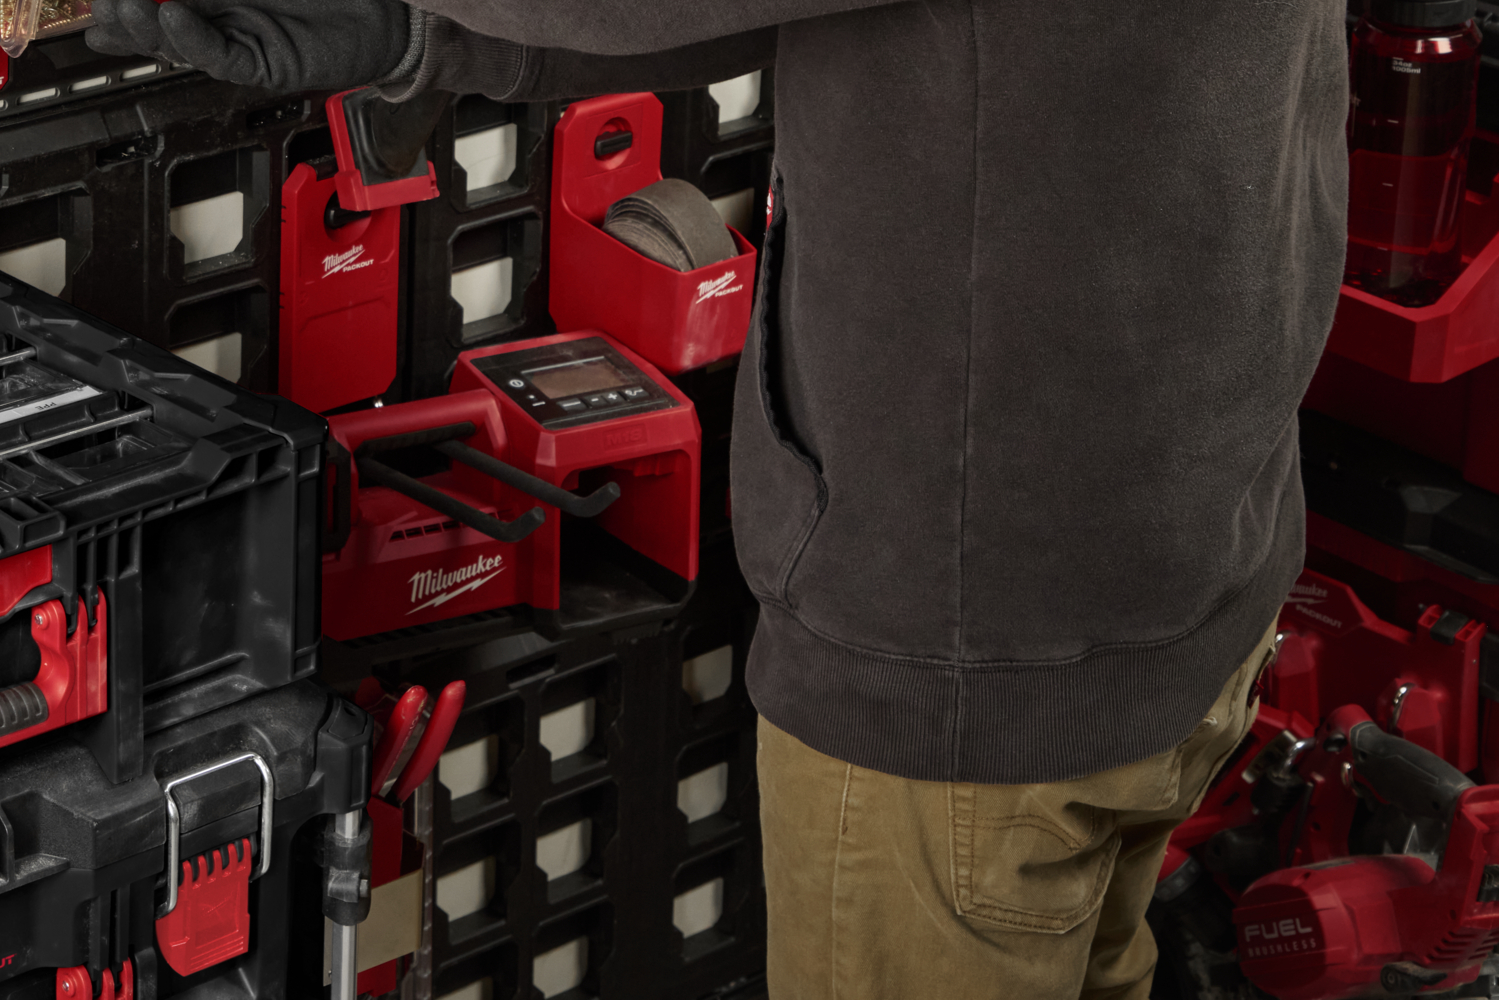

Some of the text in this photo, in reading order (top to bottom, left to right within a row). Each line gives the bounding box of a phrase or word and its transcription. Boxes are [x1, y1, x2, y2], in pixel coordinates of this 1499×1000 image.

[322, 243, 365, 273] Milwaukee
[342, 258, 374, 273] PACKOUT
[697, 270, 736, 297] Milwaukee
[407, 554, 504, 603] Milwaukee
[1244, 918, 1313, 943] FUEL
[1247, 938, 1317, 958] BRUSHLESS
